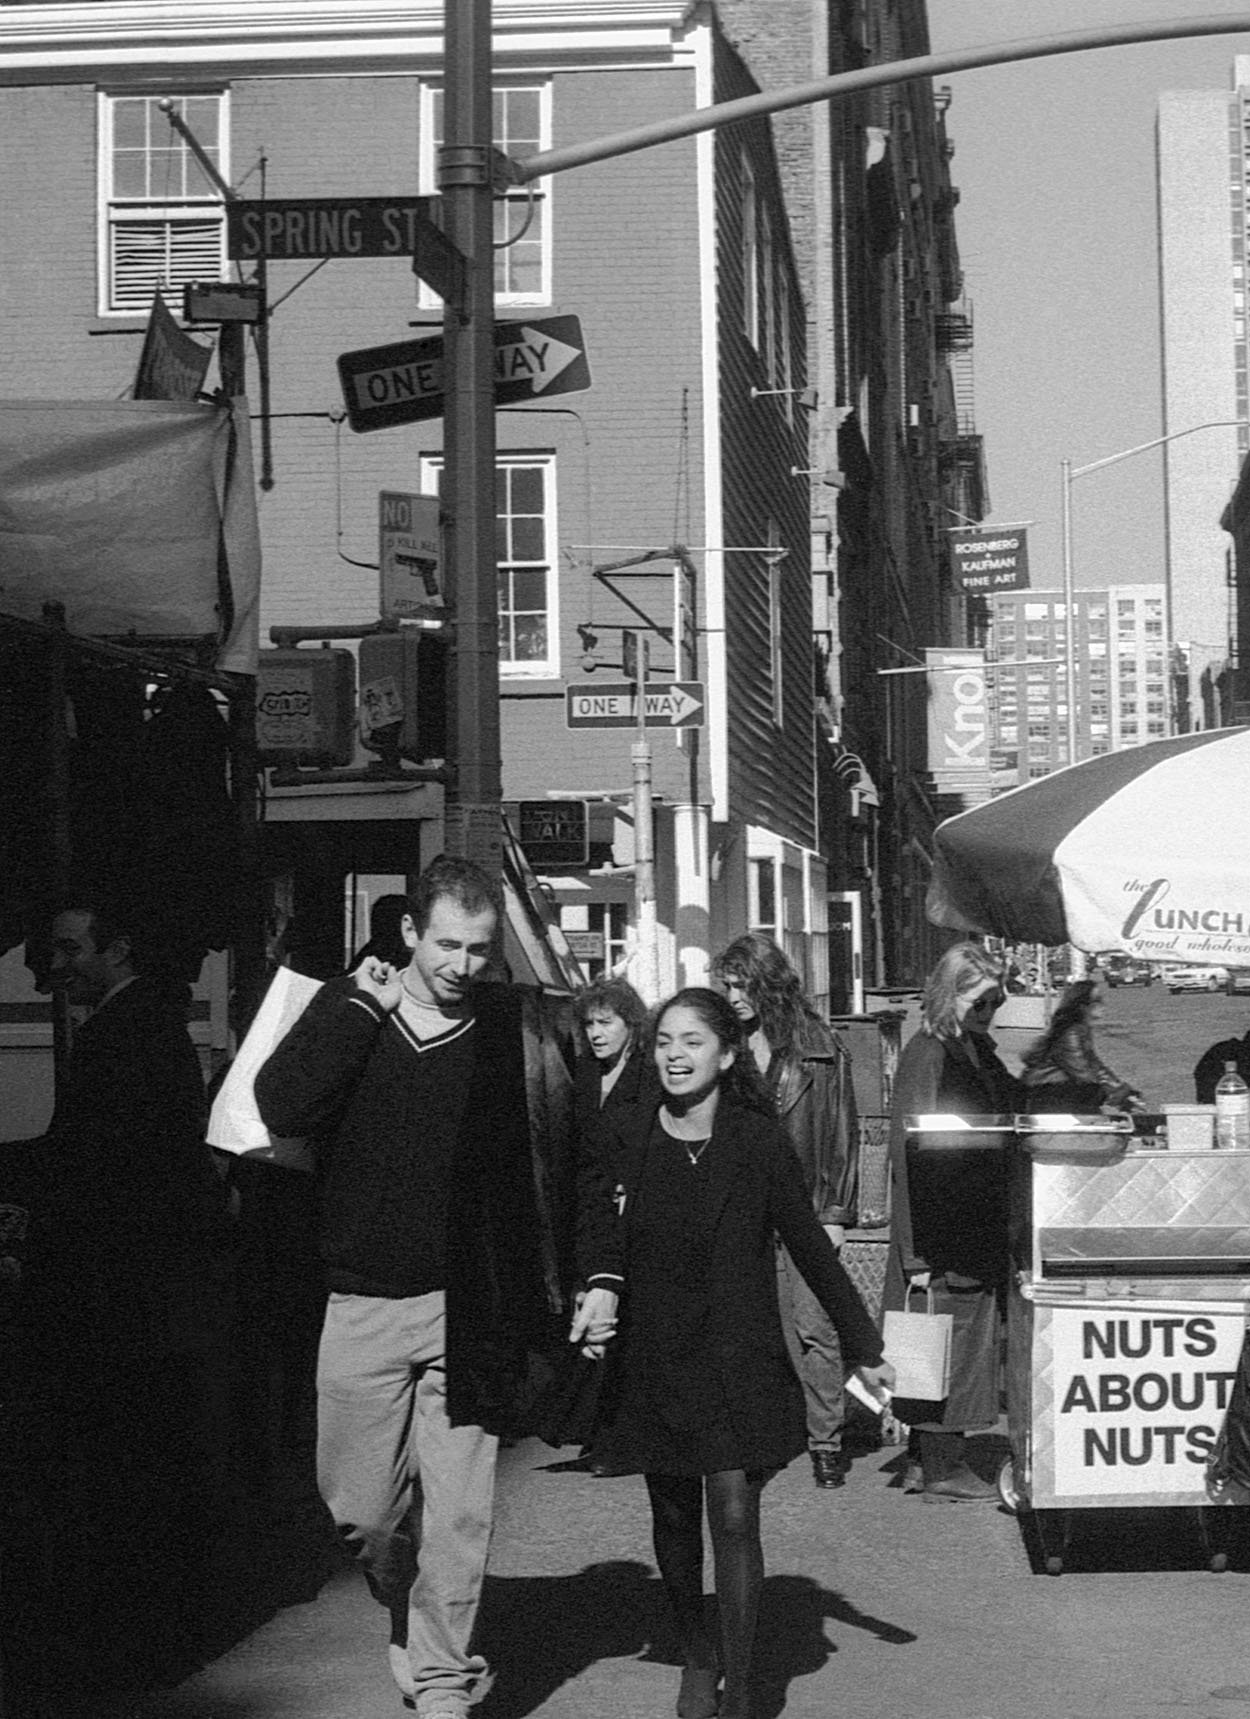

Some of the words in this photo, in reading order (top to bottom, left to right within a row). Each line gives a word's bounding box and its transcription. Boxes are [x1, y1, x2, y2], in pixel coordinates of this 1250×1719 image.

[242, 207, 363, 256] SPRING
[382, 207, 419, 253] ST
[366, 362, 439, 404] ONE
[383, 500, 410, 528] NO
[955, 538, 1020, 555] ROSENBERG
[961, 556, 1017, 572] KAUFMAN
[962, 576, 990, 587] FINE
[993, 573, 1017, 585] ART
[578, 698, 619, 715] ONE
[644, 696, 686, 714] WAY
[1123, 878, 1148, 894] the
[1130, 936, 1180, 953] good
[1082, 1318, 1218, 1360] NUTS
[1060, 1371, 1238, 1414] ABOUT
[1083, 1424, 1216, 1467] NUTS
